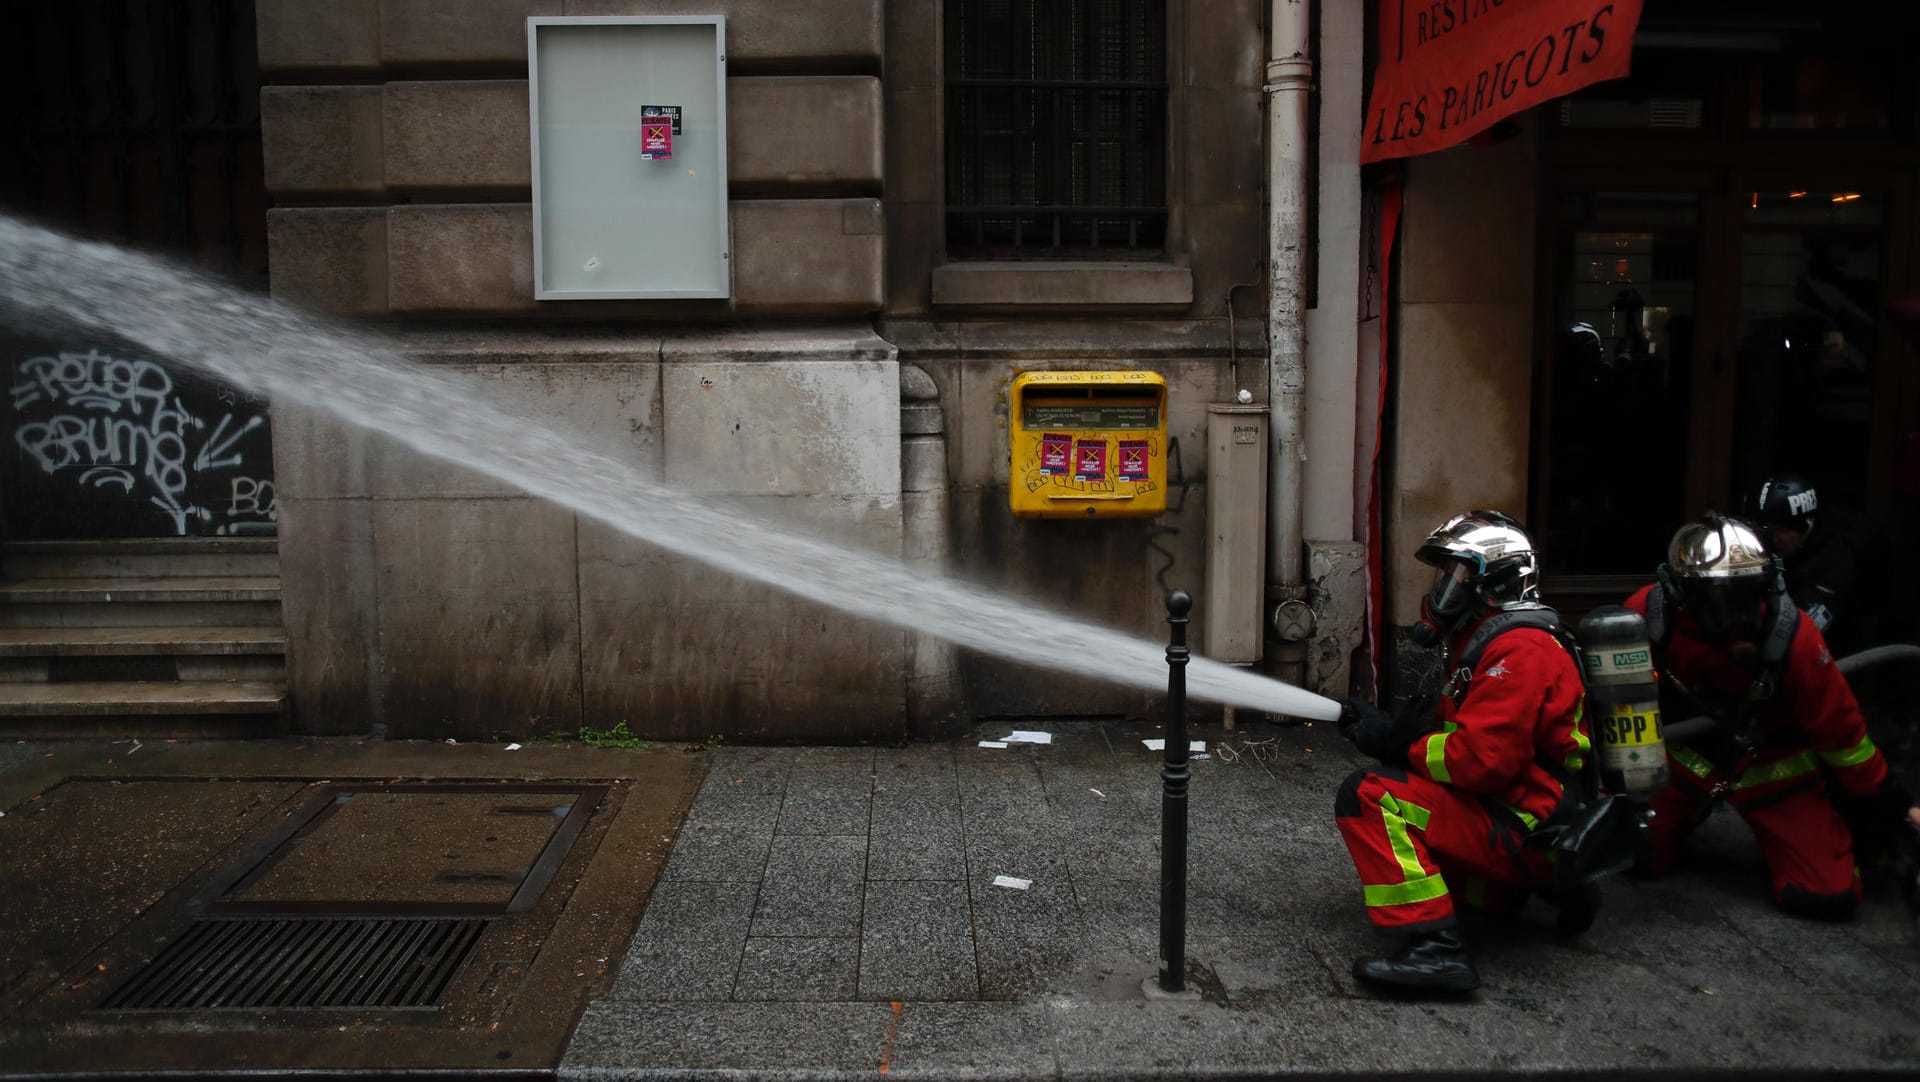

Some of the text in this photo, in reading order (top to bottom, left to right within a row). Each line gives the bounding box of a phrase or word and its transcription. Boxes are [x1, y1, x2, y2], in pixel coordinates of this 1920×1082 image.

[1373, 4, 1615, 144] LES PARIGOTS
[1615, 652, 1649, 666] MSA
